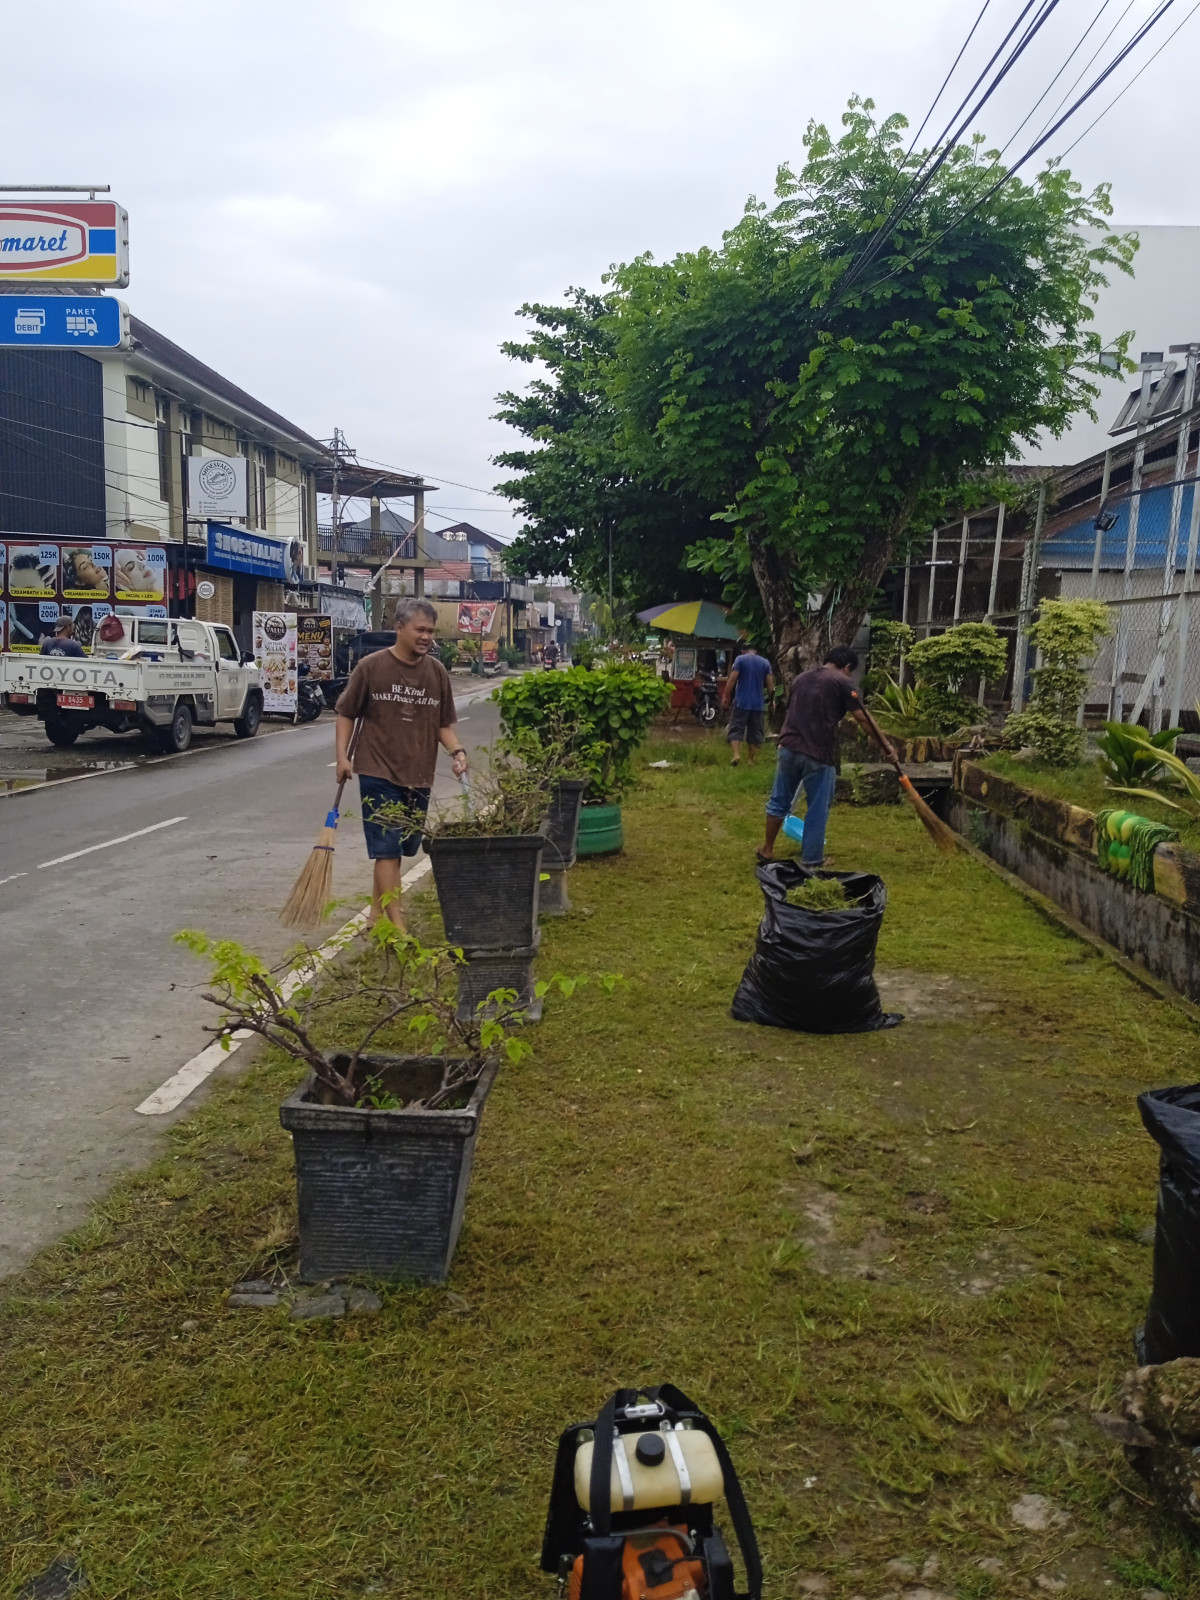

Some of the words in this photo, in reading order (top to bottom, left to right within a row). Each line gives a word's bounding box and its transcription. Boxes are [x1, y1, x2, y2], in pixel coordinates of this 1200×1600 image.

[0, 230, 68, 251] maret
[16, 324, 40, 332] DEBIT
[202, 462, 233, 476] SHOESVALUE
[215, 532, 283, 563] SHOESVALUE
[93, 552, 111, 560] 150K
[147, 554, 165, 562] 100K
[298, 632, 324, 640] MENU
[25, 666, 117, 685] TOYOTA
[392, 684, 402, 694] BE
[404, 687, 426, 696] Kind
[393, 694, 414, 704] Peace
[415, 697, 427, 705] All
[428, 698, 440, 707] Day
